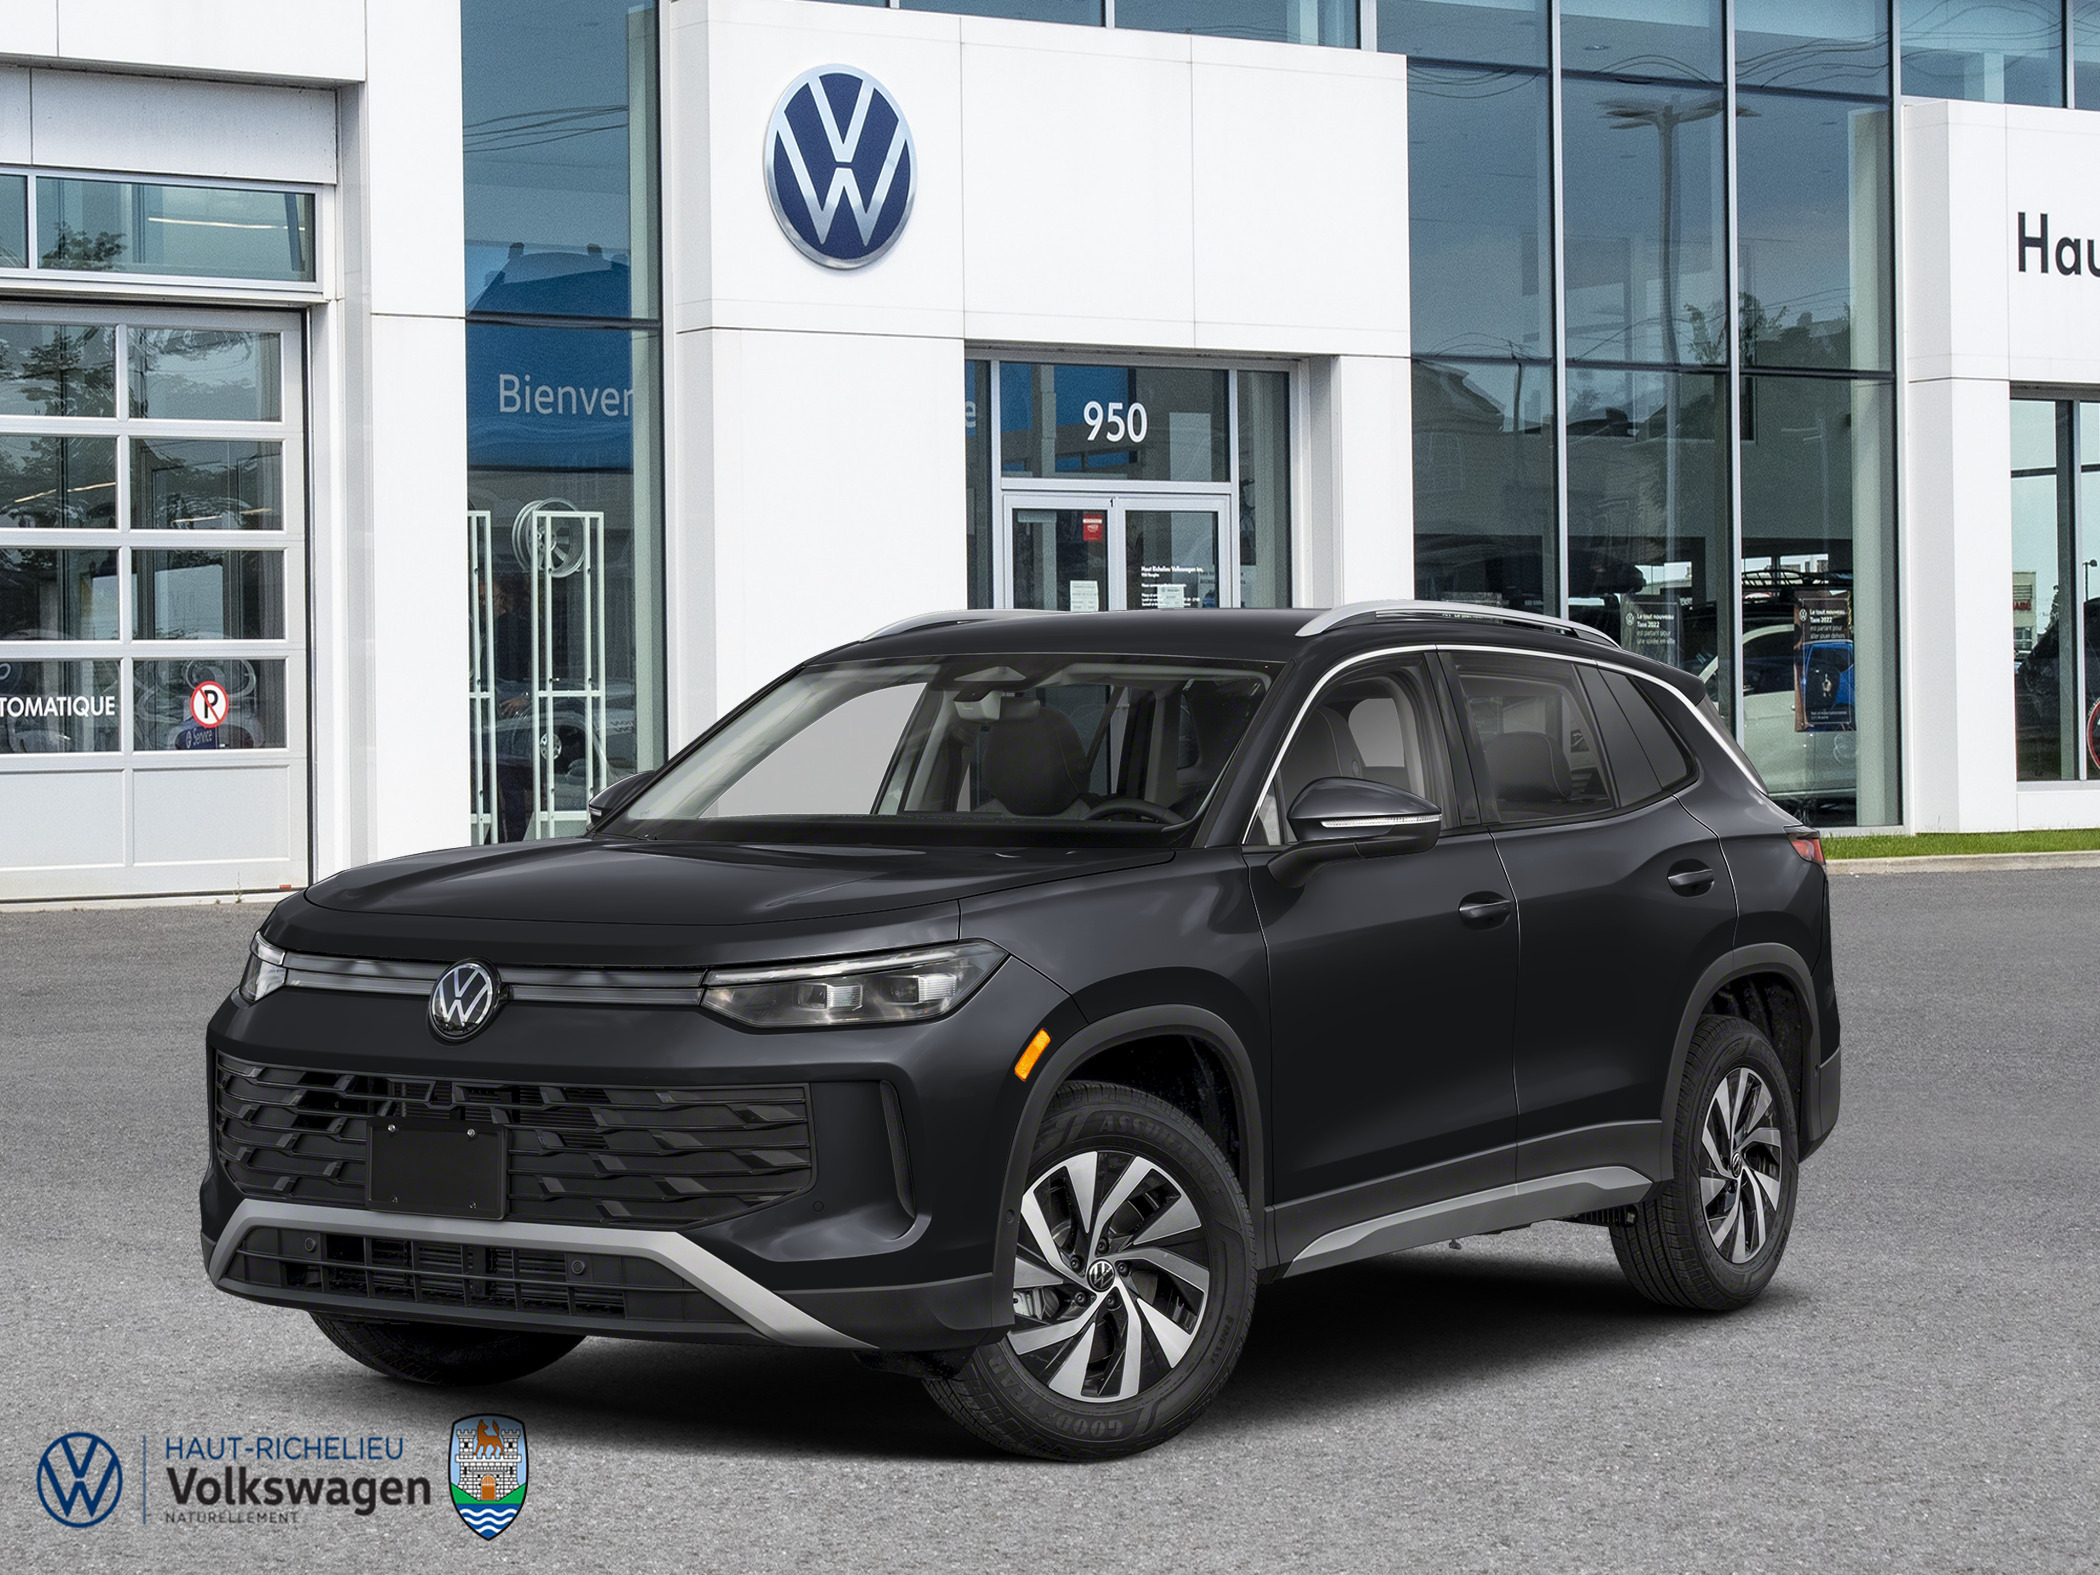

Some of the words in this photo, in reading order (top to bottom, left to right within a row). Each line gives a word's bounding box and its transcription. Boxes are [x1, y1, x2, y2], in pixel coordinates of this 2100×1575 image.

[770, 70, 910, 250] VW
[1083, 401, 1148, 442] 950
[0, 696, 115, 718] TOMATIQUE
[436, 966, 491, 1028] VW
